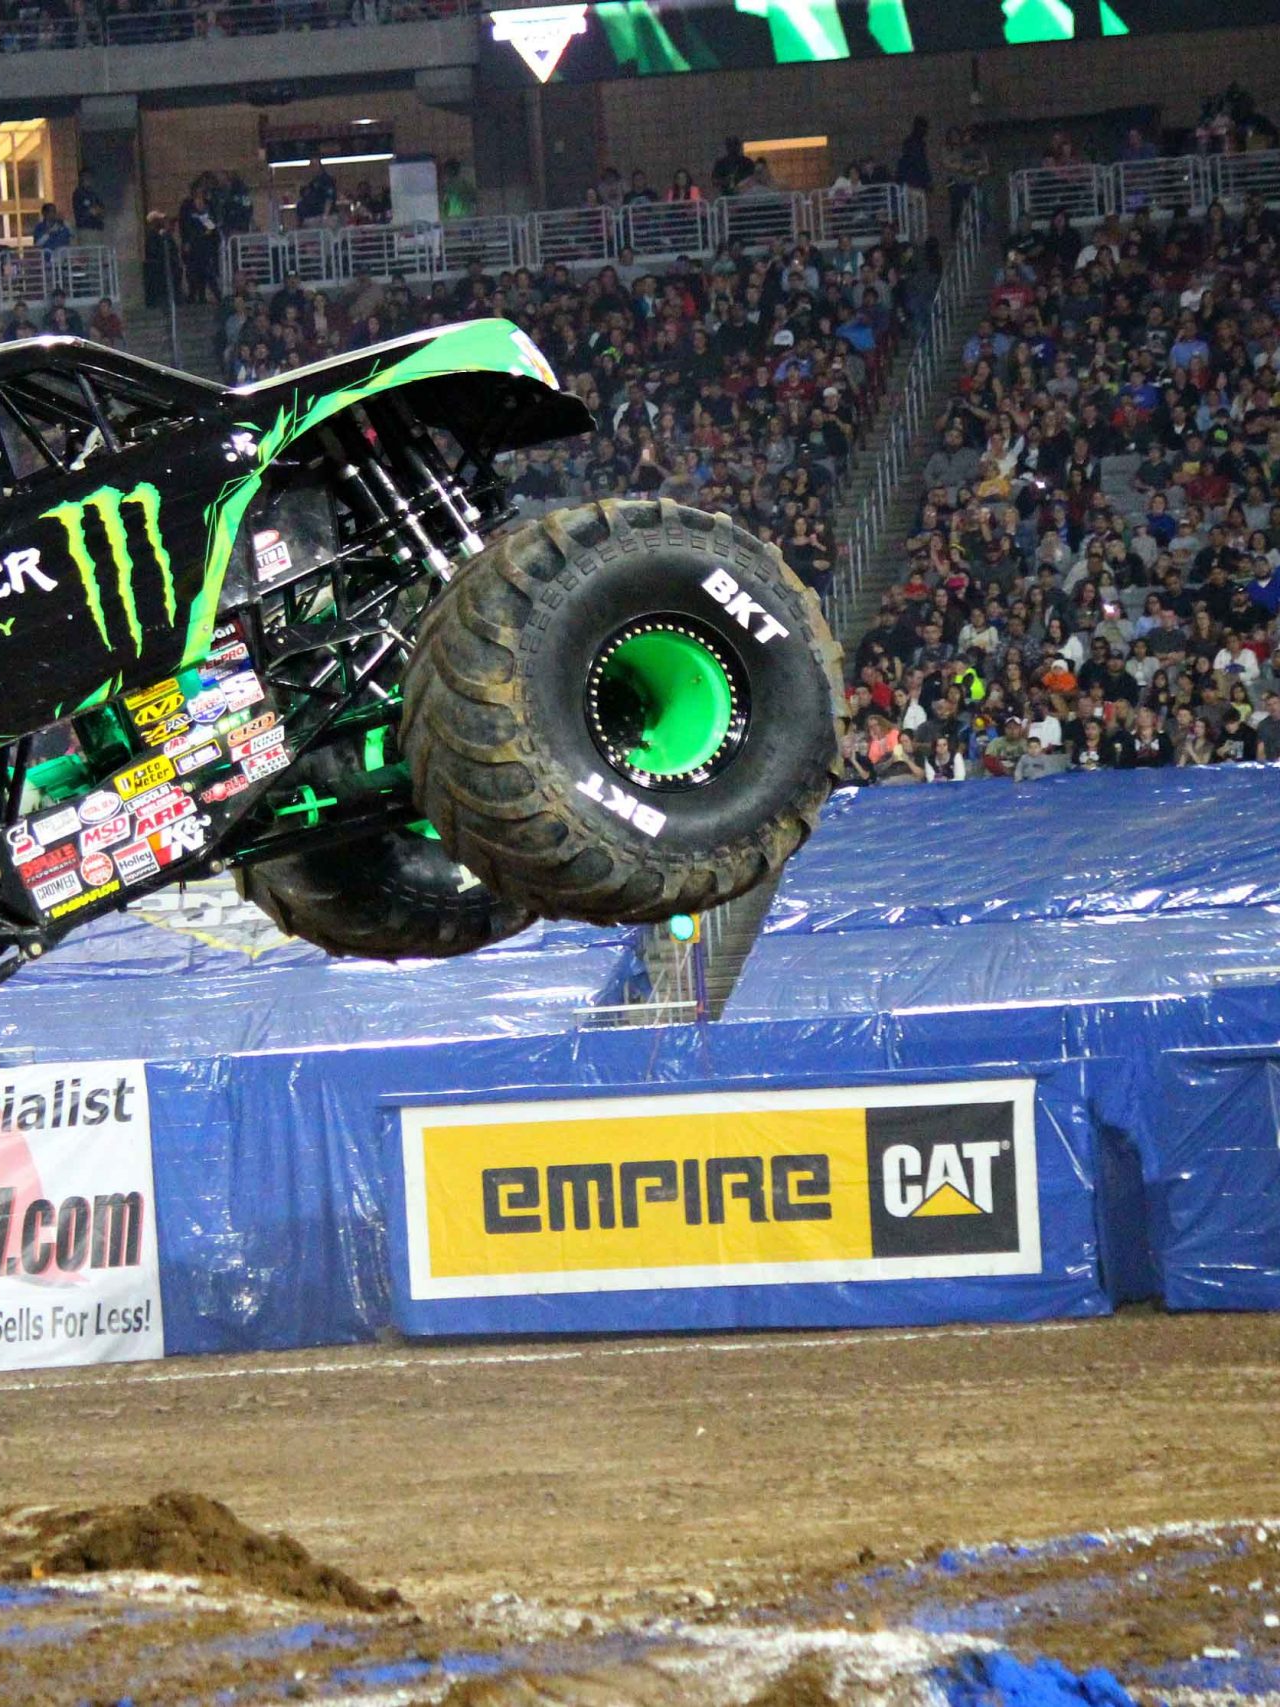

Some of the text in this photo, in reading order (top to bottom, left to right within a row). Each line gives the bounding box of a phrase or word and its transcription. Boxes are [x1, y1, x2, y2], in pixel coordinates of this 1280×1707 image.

[701, 568, 789, 644] BKT
[133, 762, 161, 780] Auto
[134, 767, 170, 789] Meter
[137, 797, 191, 836] ARP
[576, 773, 667, 838] BKT
[85, 816, 126, 847] MSD
[160, 815, 212, 860] K&N
[119, 850, 152, 871] Holley
[36, 873, 76, 901] CROWER
[881, 1141, 1002, 1219] CAT
[51, 1305, 89, 1339] For
[94, 1299, 152, 1336] Less!
